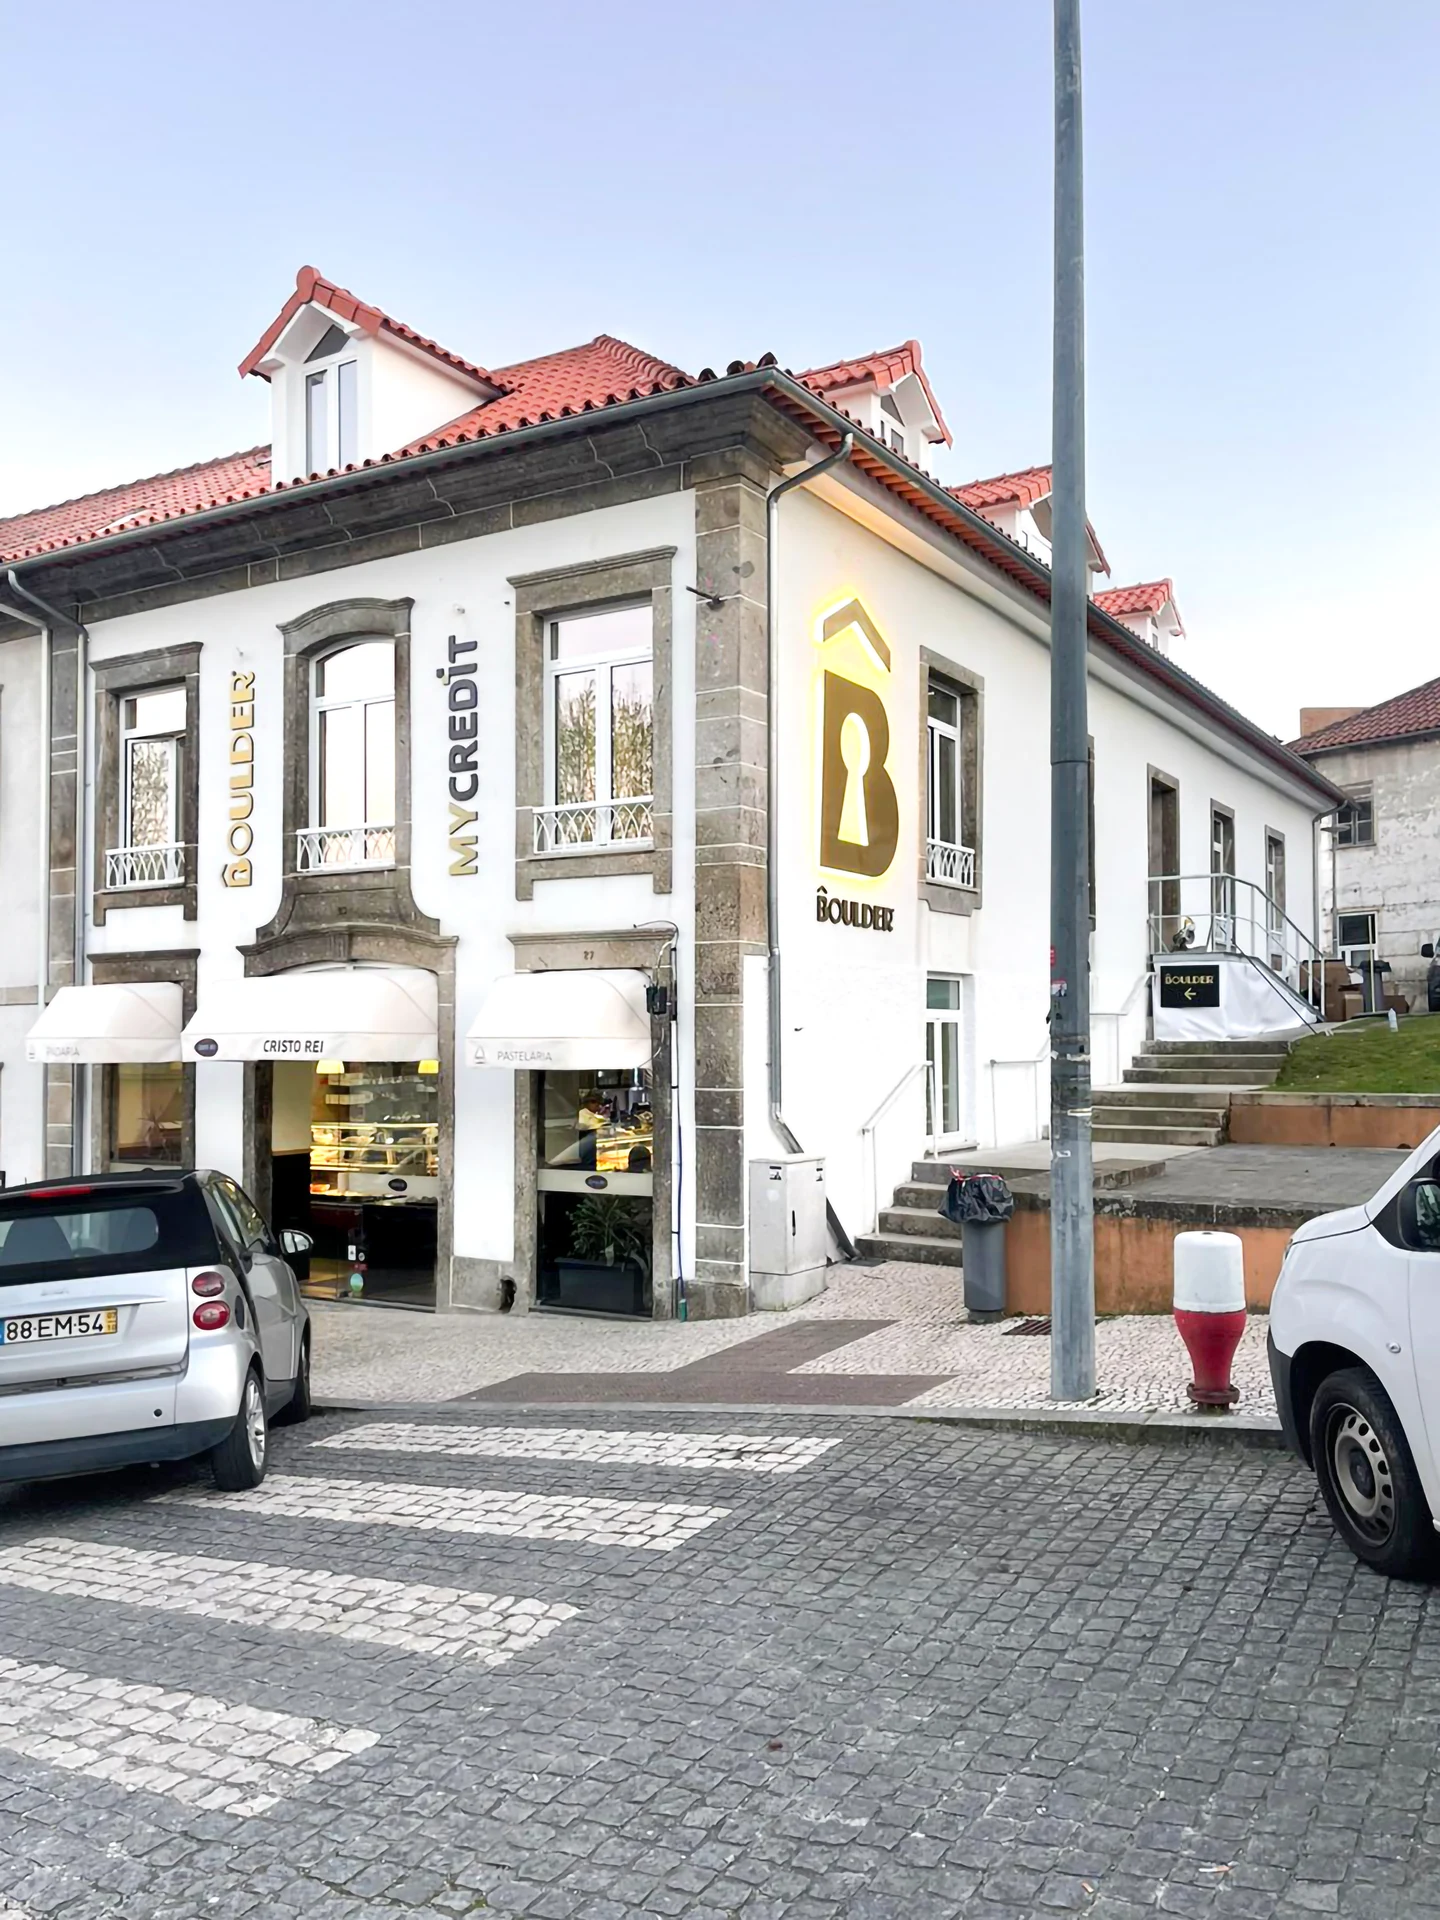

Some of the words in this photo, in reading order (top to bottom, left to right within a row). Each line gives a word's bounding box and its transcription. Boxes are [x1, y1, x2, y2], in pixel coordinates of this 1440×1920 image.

[436, 635, 478, 876] MYCREDIT
[222, 670, 255, 888] BOULDER
[816, 885, 895, 932] BOULDER
[1164, 973, 1214, 985] BOULDER
[263, 1039, 301, 1053] CRISTO
[304, 1040, 324, 1053] REI
[497, 1050, 552, 1061] PASTELARIA
